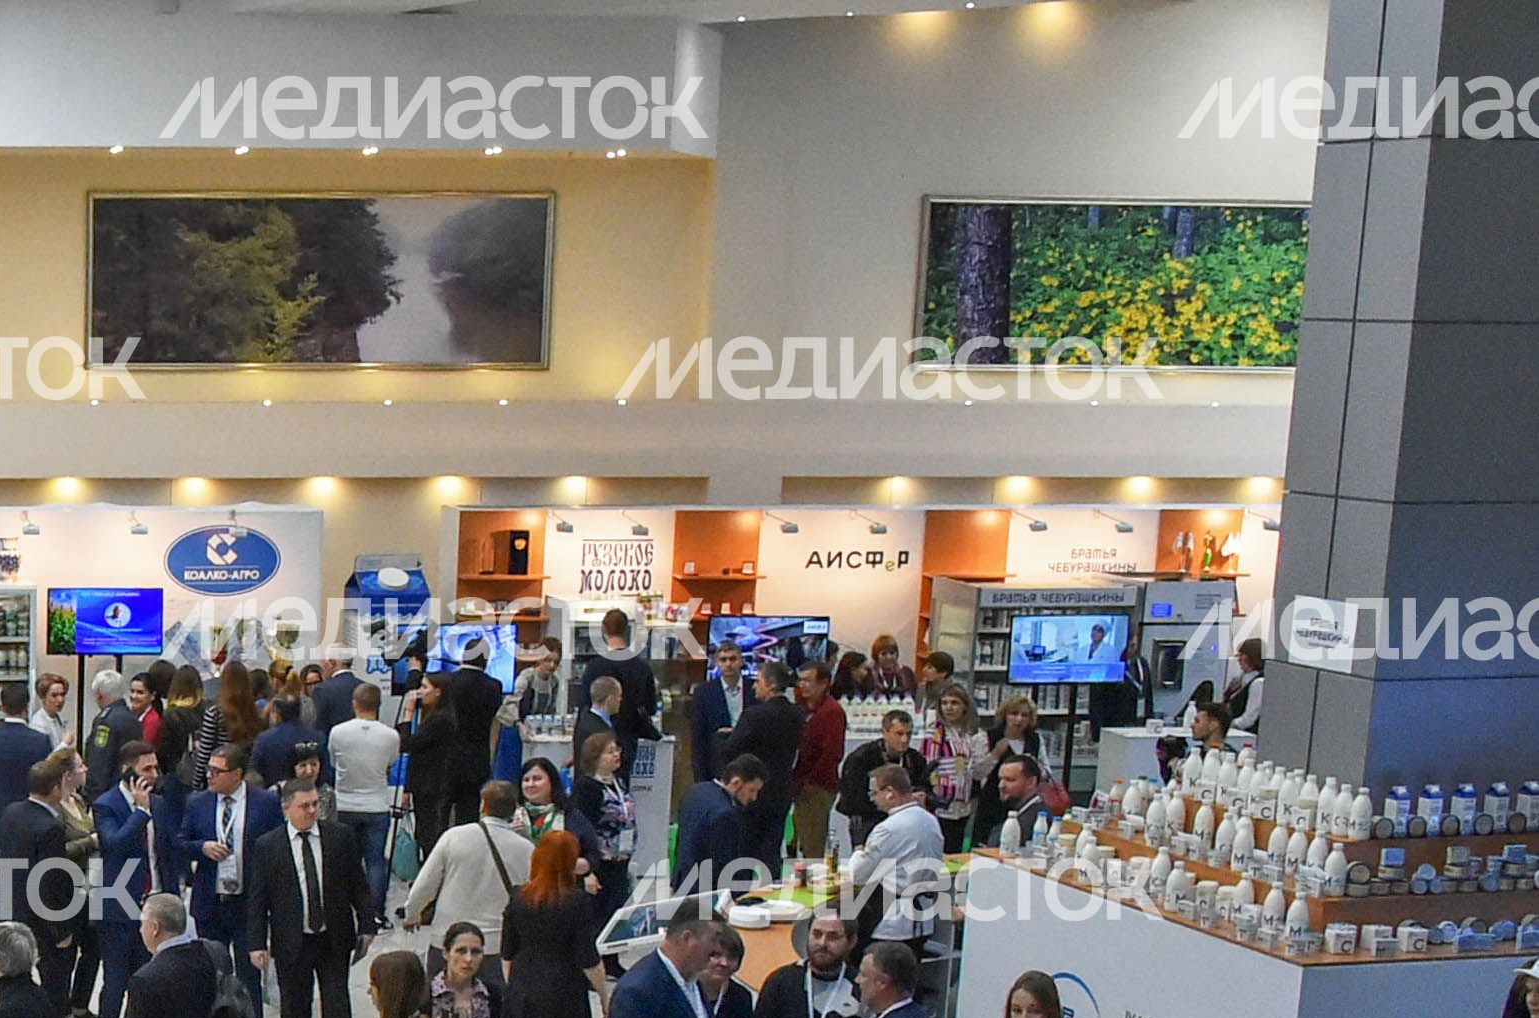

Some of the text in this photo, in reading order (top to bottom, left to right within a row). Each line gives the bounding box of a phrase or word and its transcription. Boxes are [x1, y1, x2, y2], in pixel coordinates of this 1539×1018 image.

[581, 543, 654, 567] РУЗСКОЕ
[184, 570, 260, 581] КОАЛКО-АГРО
[579, 569, 652, 594] МОЛОКО
